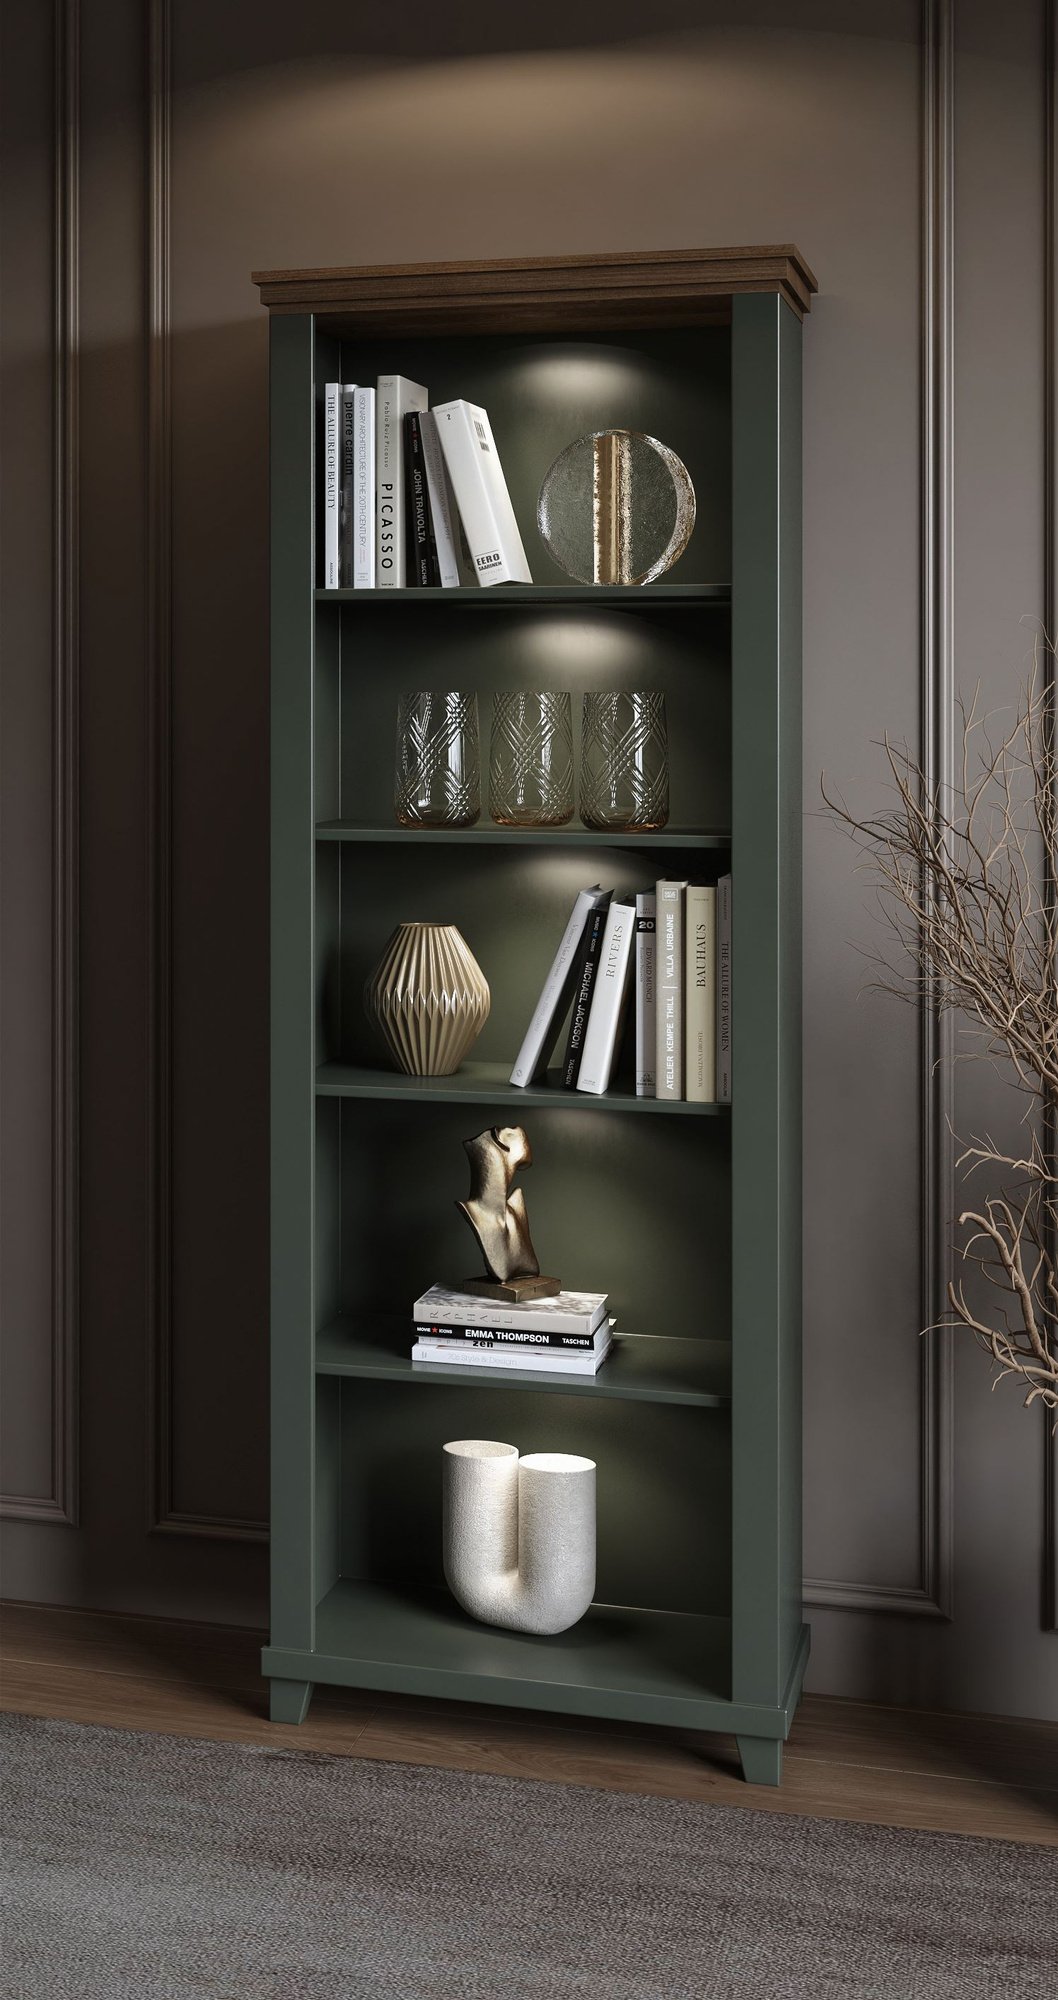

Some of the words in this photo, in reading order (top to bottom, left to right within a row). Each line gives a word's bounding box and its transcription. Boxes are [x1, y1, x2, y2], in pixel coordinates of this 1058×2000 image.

[327, 395, 335, 415] THE
[344, 402, 354, 436] pierre
[327, 417, 335, 455] ALLURE
[327, 456, 335, 470] OF
[345, 440, 354, 476] cardin
[359, 472, 366, 481] OF
[413, 469, 422, 494] JOHN
[327, 471, 335, 510] BEAUTY
[381, 483, 393, 569] PICASSO
[415, 495, 426, 543] TRAVOLTA
[420, 558, 428, 585] TASCHEN
[476, 553, 500, 566] EERO
[478, 561, 502, 571] SAARINEN
[638, 920, 654, 929] 20
[666, 914, 674, 951] URBAINE
[605, 924, 623, 978] RIVERS
[696, 924, 706, 988] BAUHAUS
[721, 942, 729, 962] THE
[666, 954, 674, 978] VILLA
[578, 962, 594, 1004] MICHAEL
[721, 963, 729, 999] ALLURE
[666, 996, 674, 1019] THILL
[721, 1000, 729, 1012] OF
[571, 1004, 587, 1049] JACKSON
[666, 1023, 674, 1052] KEMPE
[721, 1013, 729, 1052] WOMEN
[565, 1059, 575, 1085] TASCHEN
[666, 1056, 674, 1090] ATELIER
[430, 1311, 513, 1324] RAPHAEL
[465, 1329, 494, 1339] EMMA
[495, 1331, 550, 1344] THOMPSON
[472, 1340, 494, 1348] zen
[562, 1337, 590, 1346] TASCHEN
[462, 1353, 480, 1363] Style
[489, 1356, 518, 1366] Design
